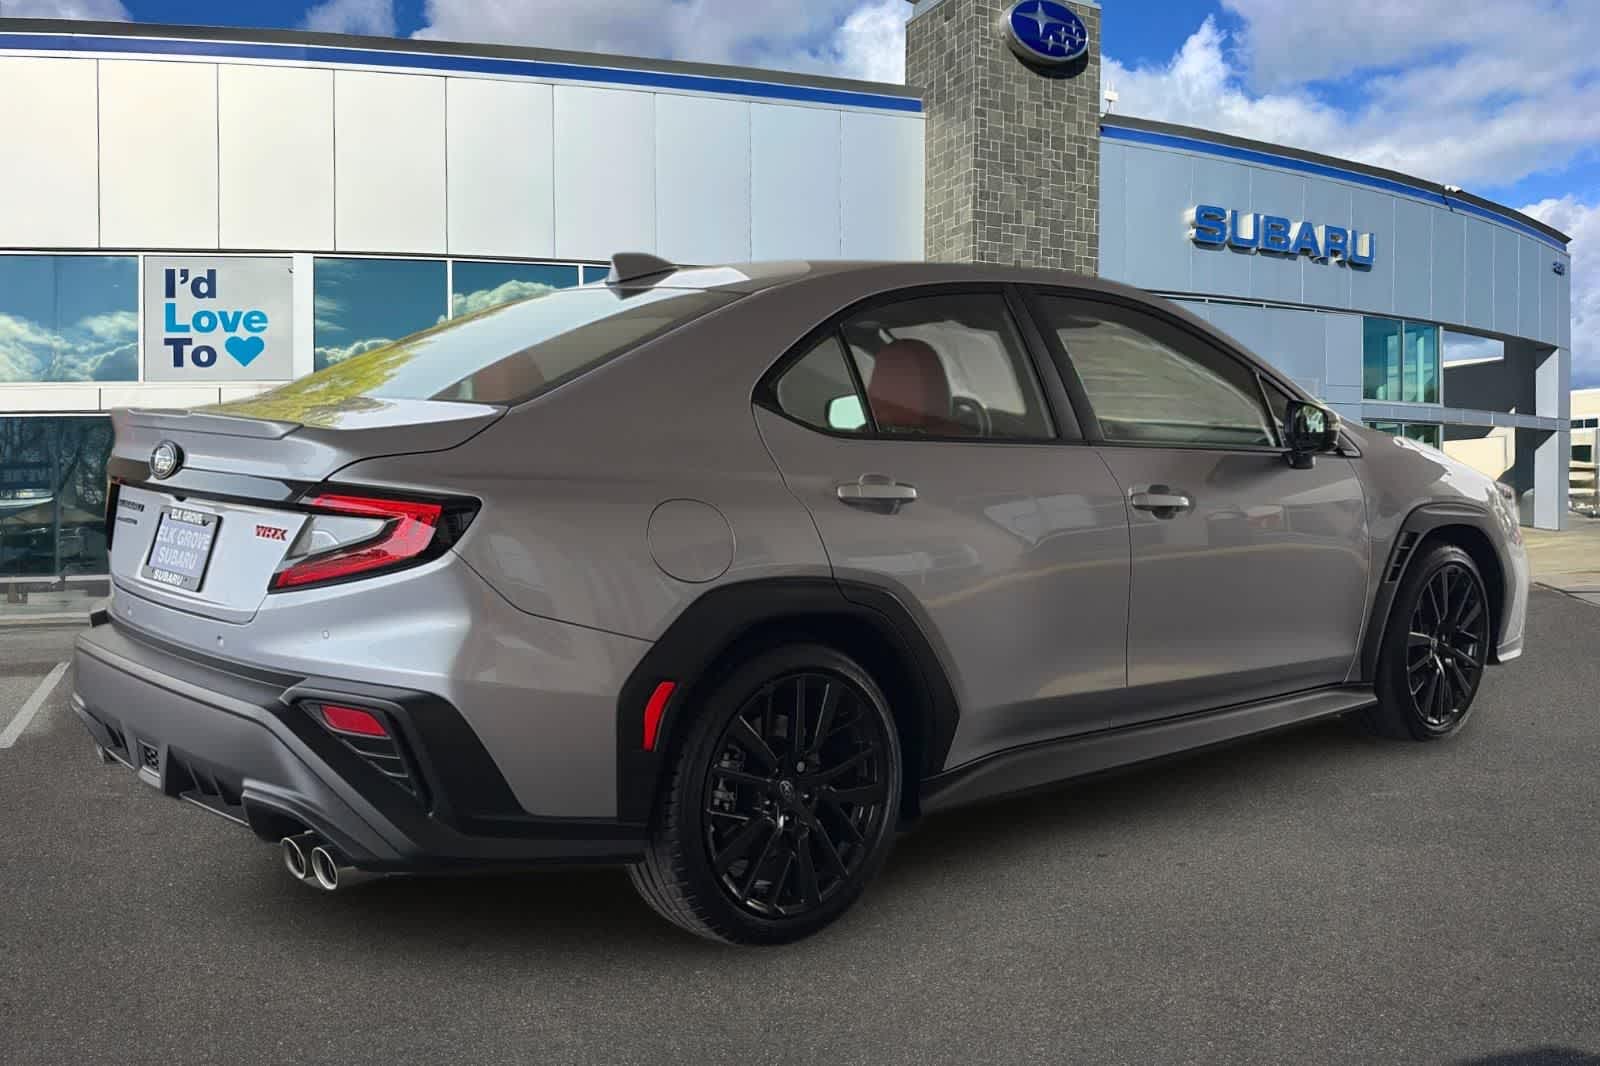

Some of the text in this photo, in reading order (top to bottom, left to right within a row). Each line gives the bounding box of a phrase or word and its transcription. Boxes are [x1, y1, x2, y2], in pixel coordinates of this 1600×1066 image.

[1193, 205, 1376, 265] SUBARU
[165, 303, 268, 333] Love
[164, 338, 217, 368] To
[171, 508, 203, 525] ELK GROVE
[159, 526, 211, 550] ELK GROVE
[256, 525, 288, 541] WRX
[159, 547, 198, 569] SUBARU
[153, 569, 184, 586] SUBARU
